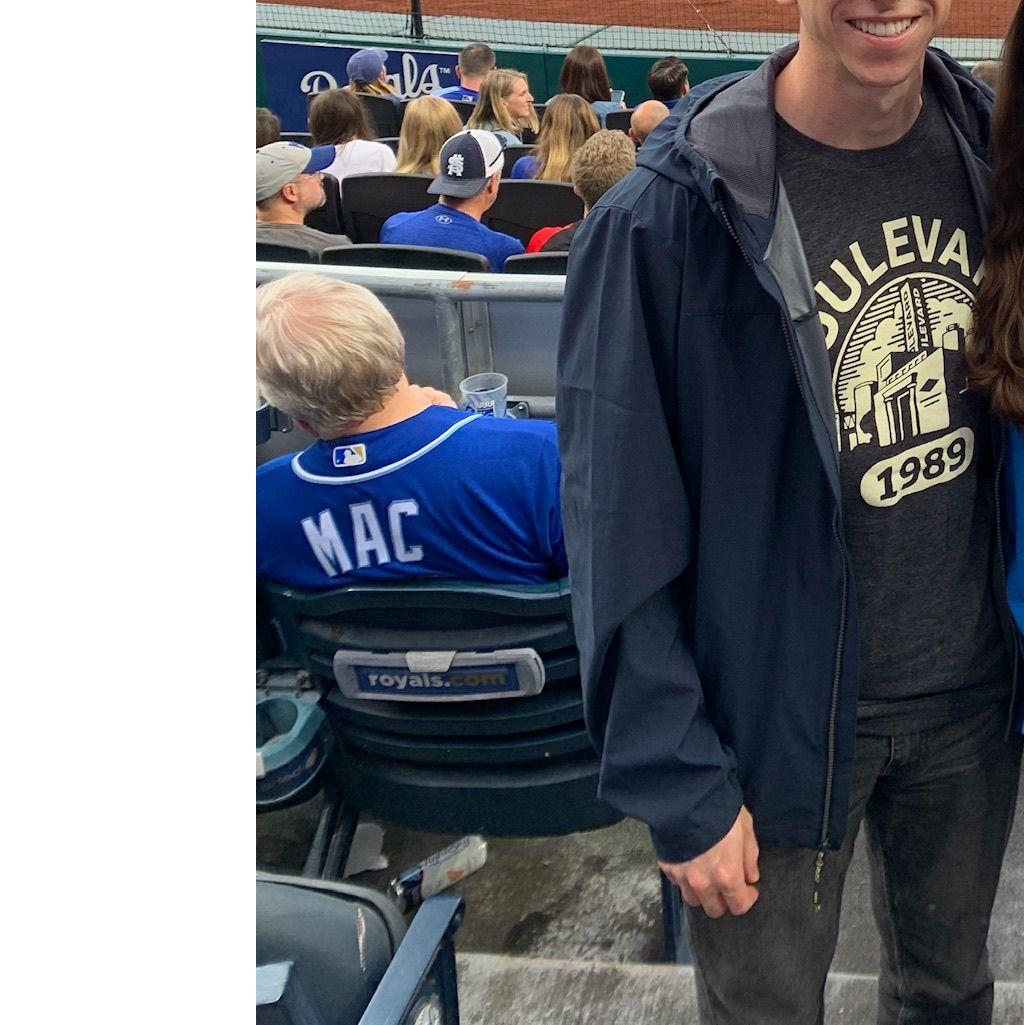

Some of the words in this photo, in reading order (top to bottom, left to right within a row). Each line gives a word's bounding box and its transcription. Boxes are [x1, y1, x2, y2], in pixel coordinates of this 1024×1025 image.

[877, 437, 966, 501] 1989
[301, 498, 424, 578] MAC
[368, 673, 506, 690] royals.com
